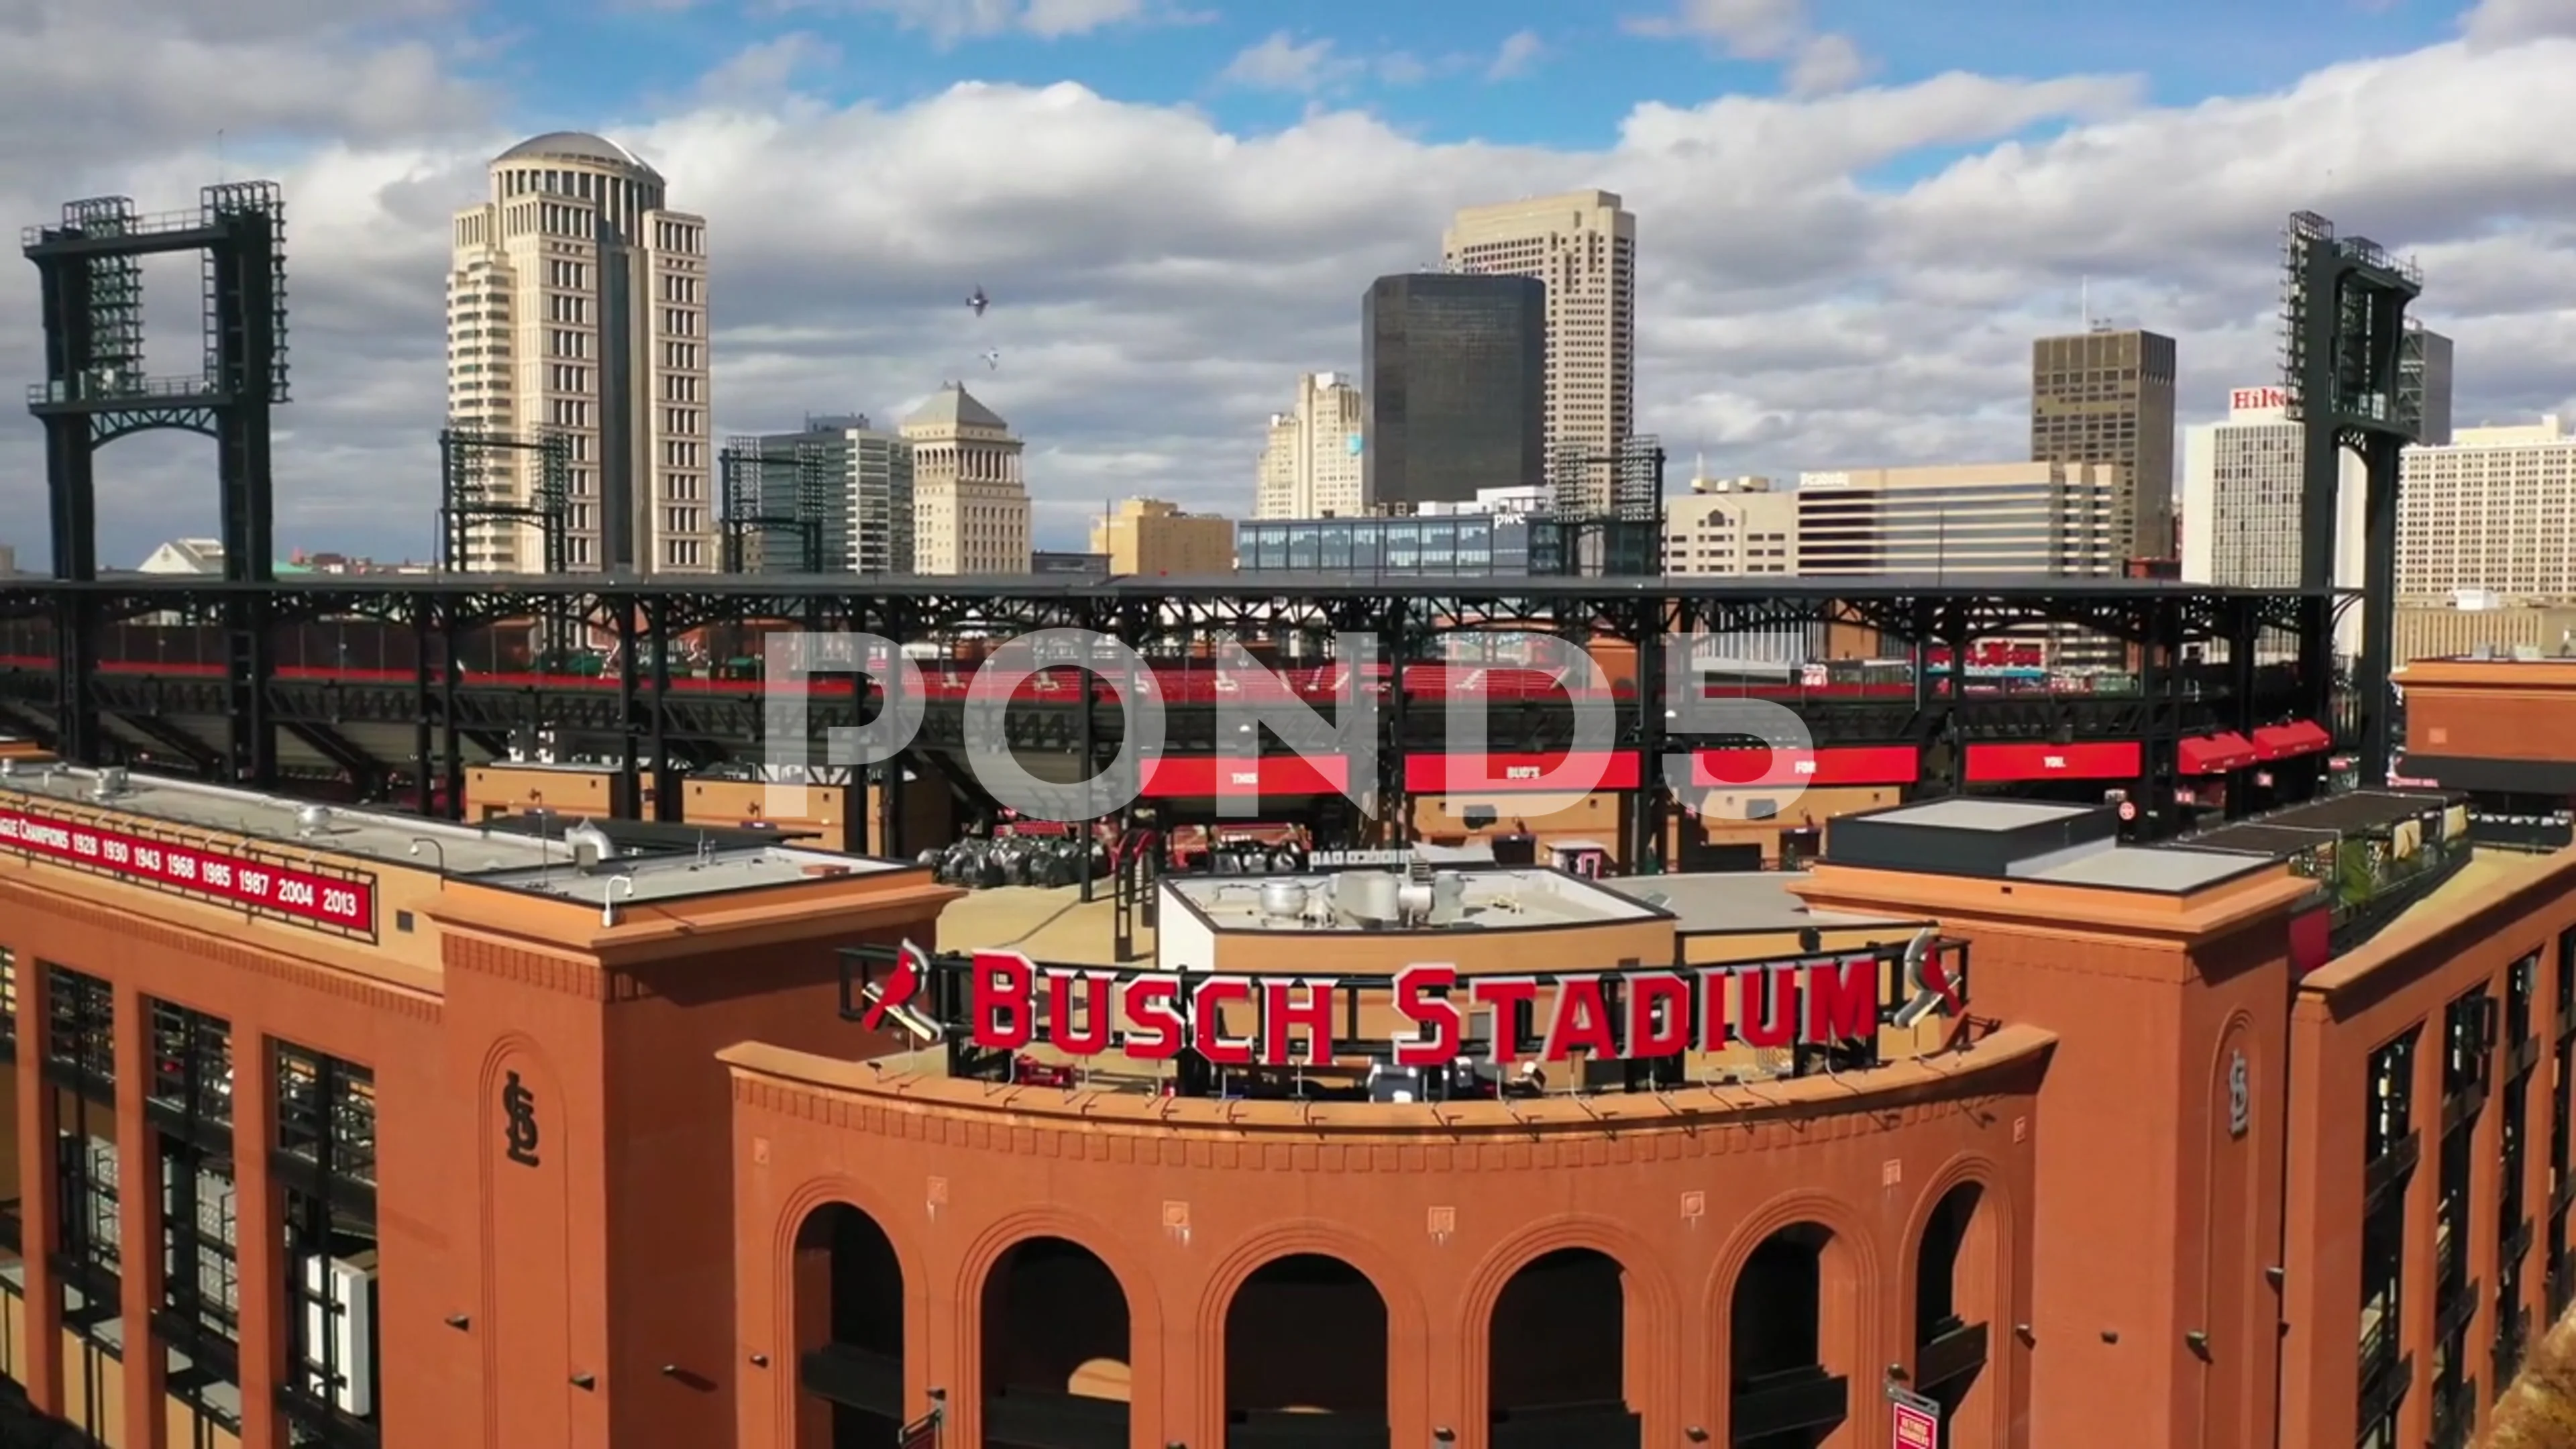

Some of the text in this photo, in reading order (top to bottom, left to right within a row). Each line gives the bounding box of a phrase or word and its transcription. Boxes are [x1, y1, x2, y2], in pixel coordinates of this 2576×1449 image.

[1232, 772, 1256, 784] THIS
[1794, 761, 1816, 773] FOR
[72, 833, 97, 856] 1928
[103, 839, 128, 863] 1930
[134, 847, 160, 871] 1943
[166, 853, 195, 879] 1968
[202, 861, 231, 888] 1985
[239, 869, 270, 896] 1987
[278, 878, 314, 906] 2004
[323, 888, 357, 917] 2013
[971, 949, 1876, 1065] BUSCH STADIUM
